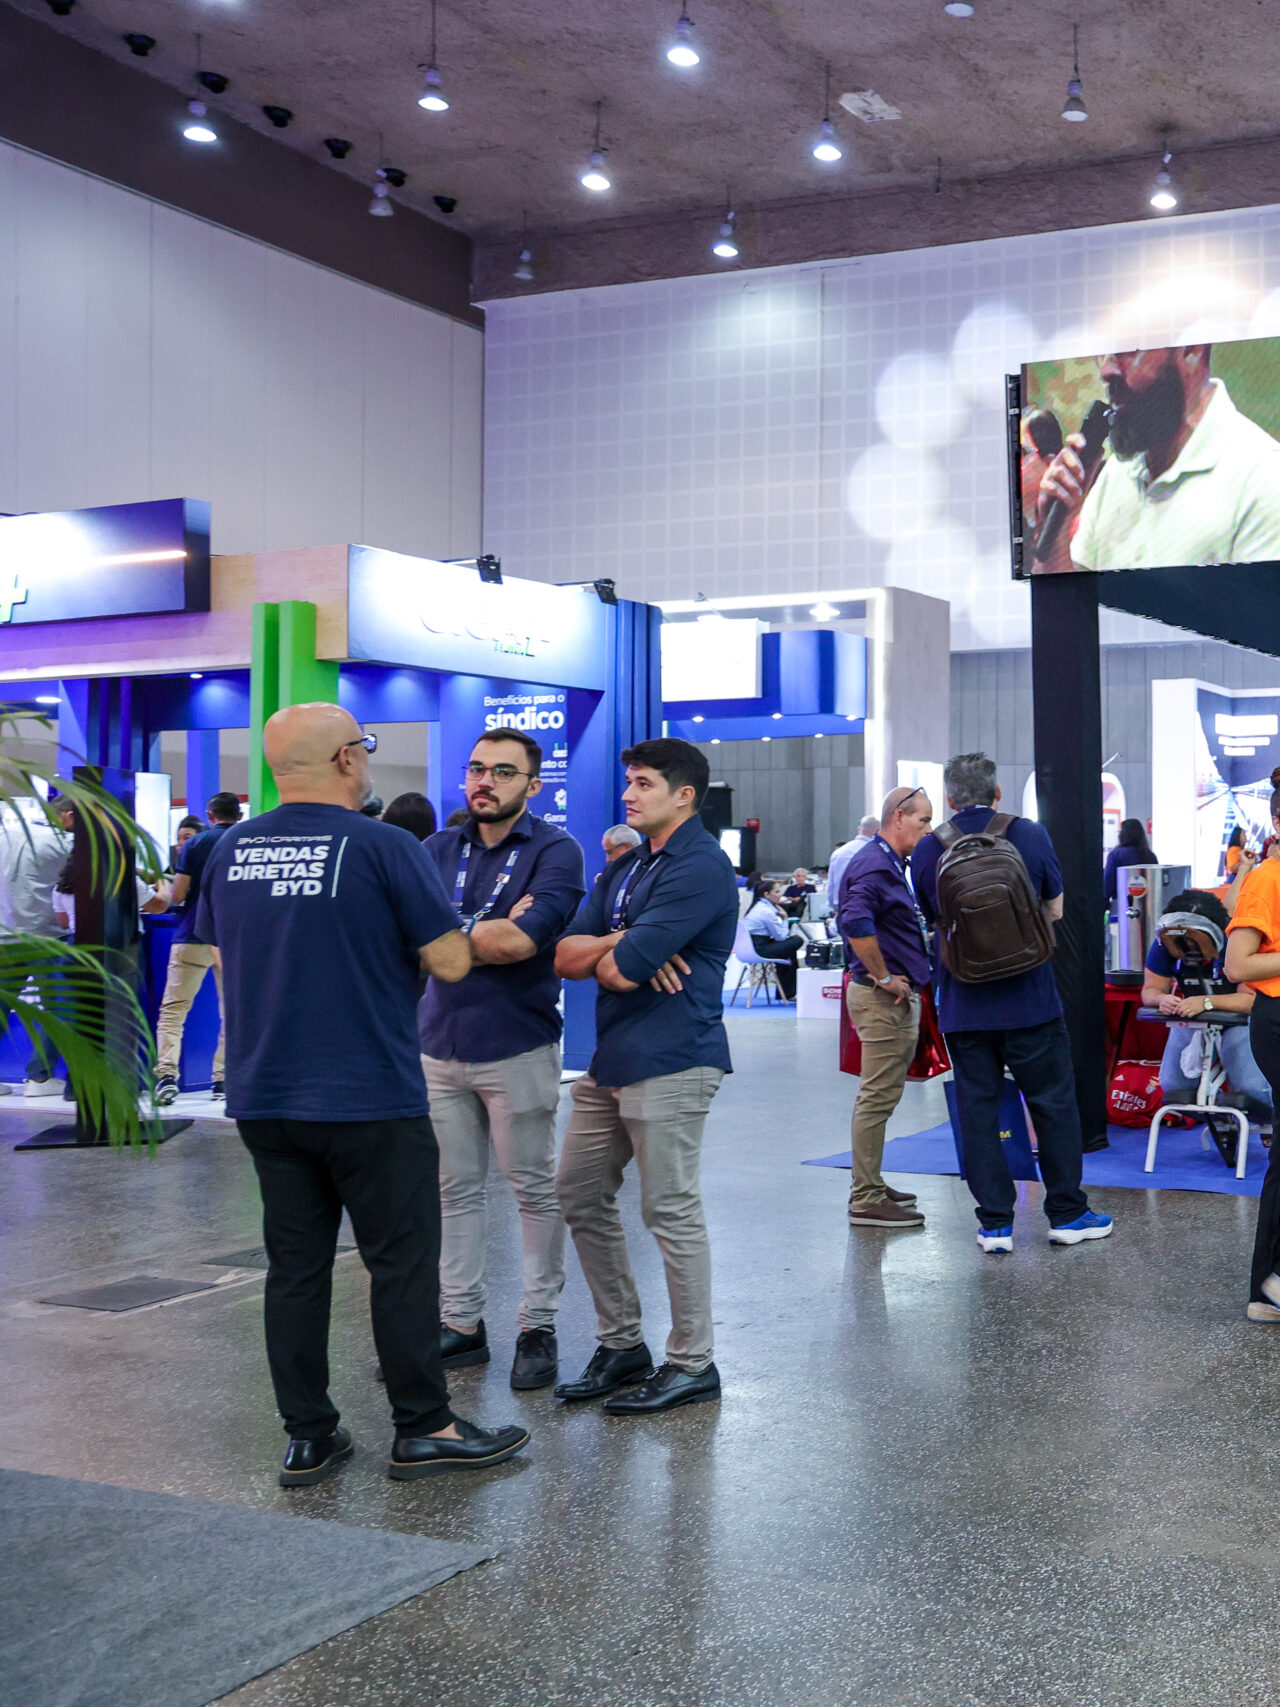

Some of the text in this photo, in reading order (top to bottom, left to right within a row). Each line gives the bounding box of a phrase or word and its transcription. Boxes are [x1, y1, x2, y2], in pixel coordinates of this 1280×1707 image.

[484, 694, 565, 707] Benefícios para o
[484, 706, 565, 732] síndico
[234, 845, 330, 864] VENDAS
[227, 862, 325, 881] DIRETAS
[271, 880, 323, 896] BYD
